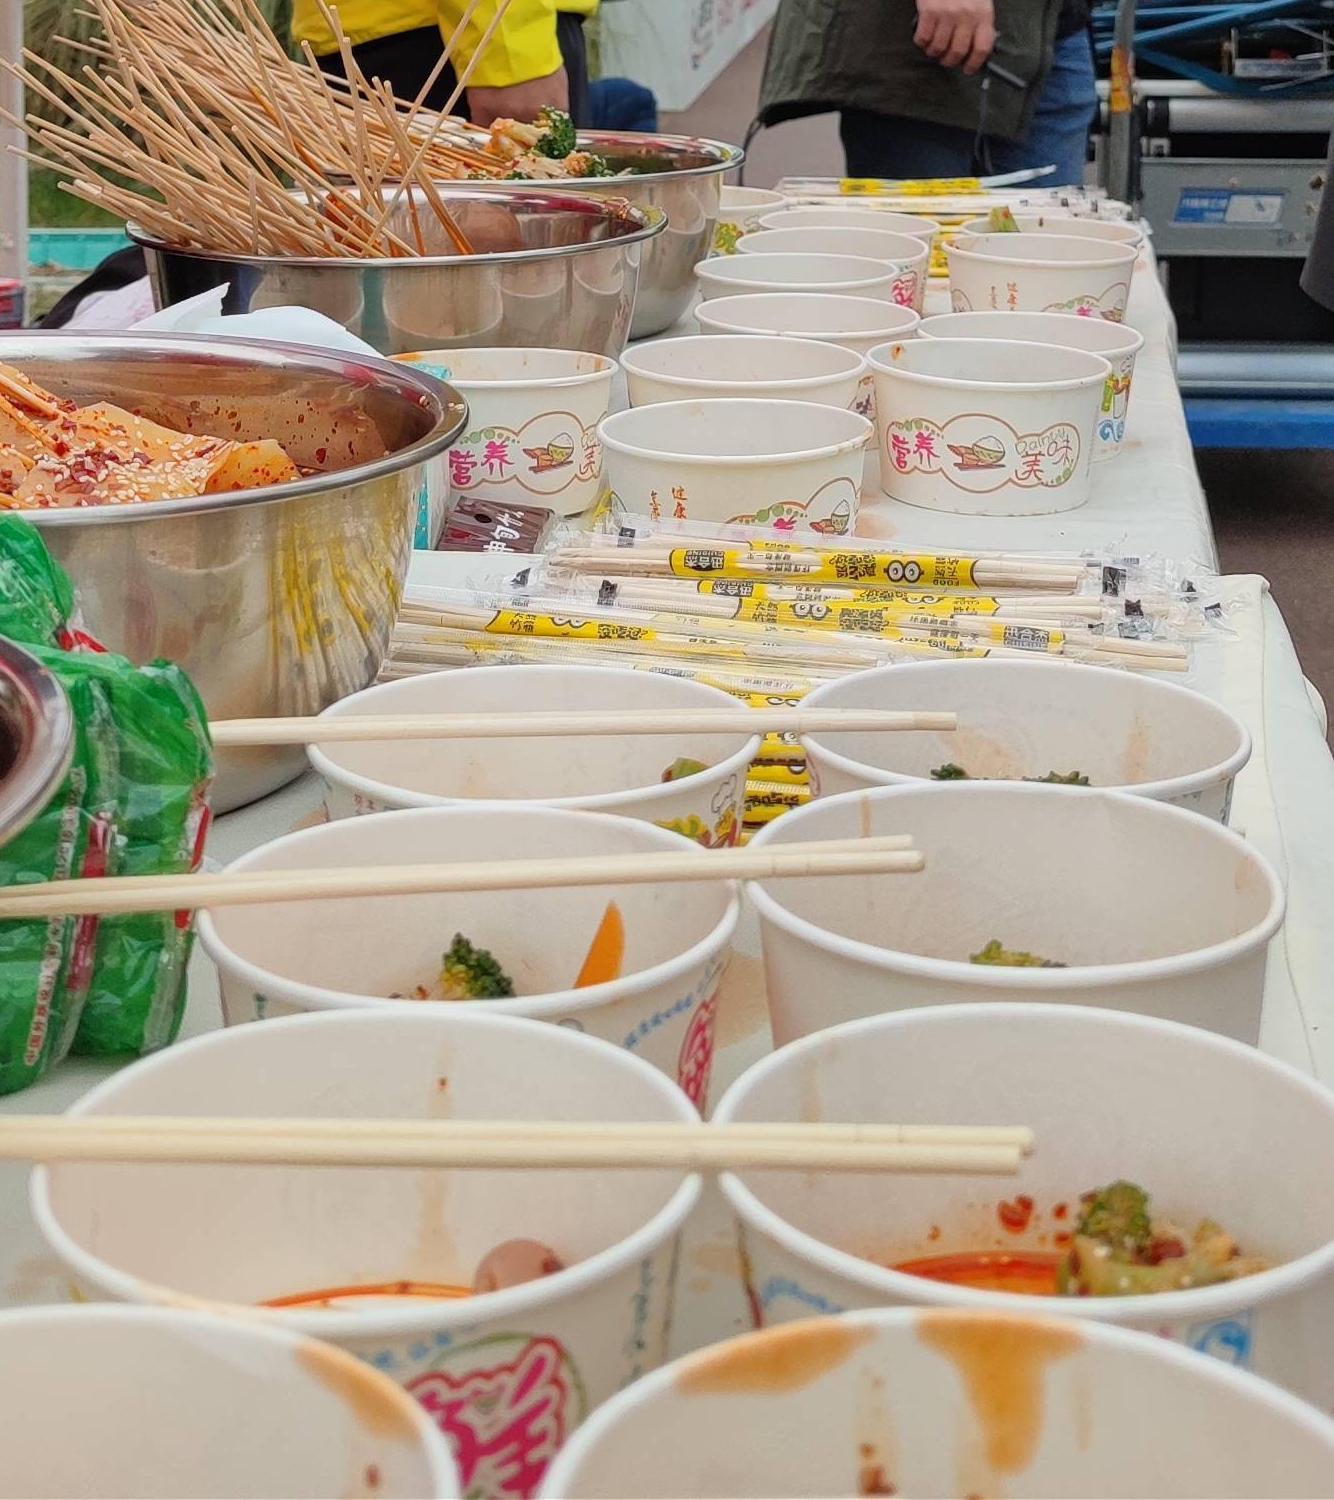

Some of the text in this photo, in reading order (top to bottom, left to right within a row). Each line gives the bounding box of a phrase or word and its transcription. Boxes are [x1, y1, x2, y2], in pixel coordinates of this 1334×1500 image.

[449, 440, 515, 486] 营养
[891, 431, 1073, 481] 营养 美味
[932, 578, 960, 587] FOOD
